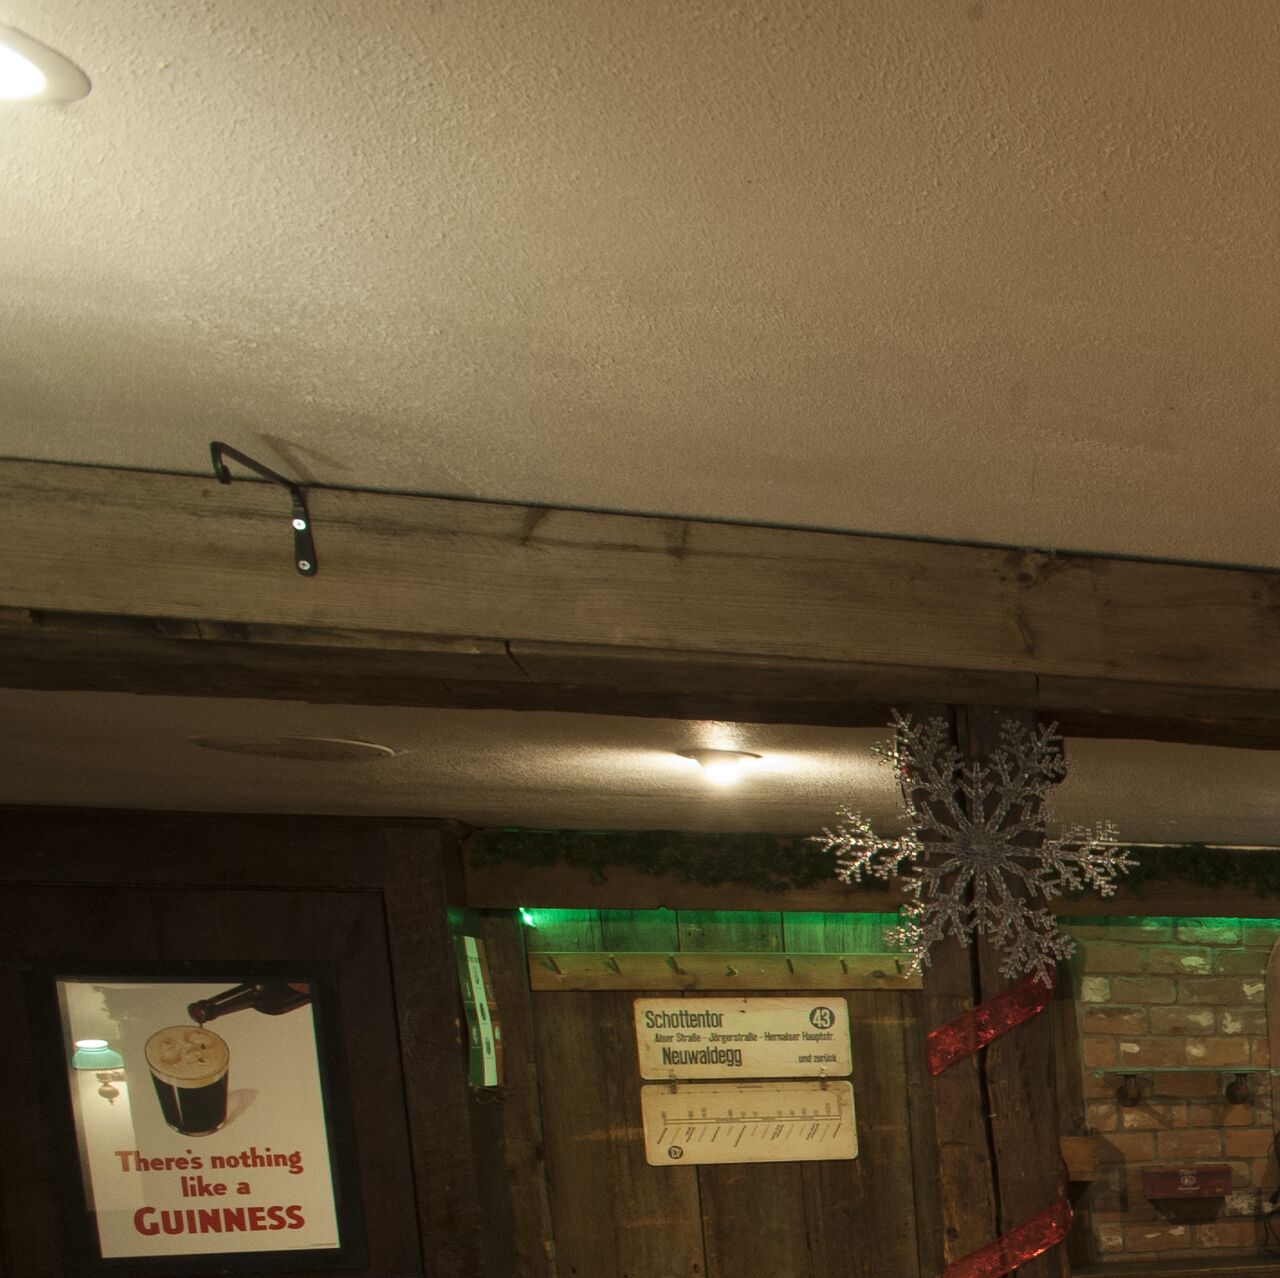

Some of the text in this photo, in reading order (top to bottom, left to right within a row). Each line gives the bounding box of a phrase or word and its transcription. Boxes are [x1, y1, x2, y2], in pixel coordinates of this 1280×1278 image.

[645, 1009, 724, 1029] Schottentor
[812, 1008, 831, 1029] 43
[662, 1046, 743, 1067] Neuwaldegg
[115, 1147, 304, 1175] There's nothing
[181, 1175, 252, 1198] like a
[134, 1205, 306, 1236] GUINNESS
